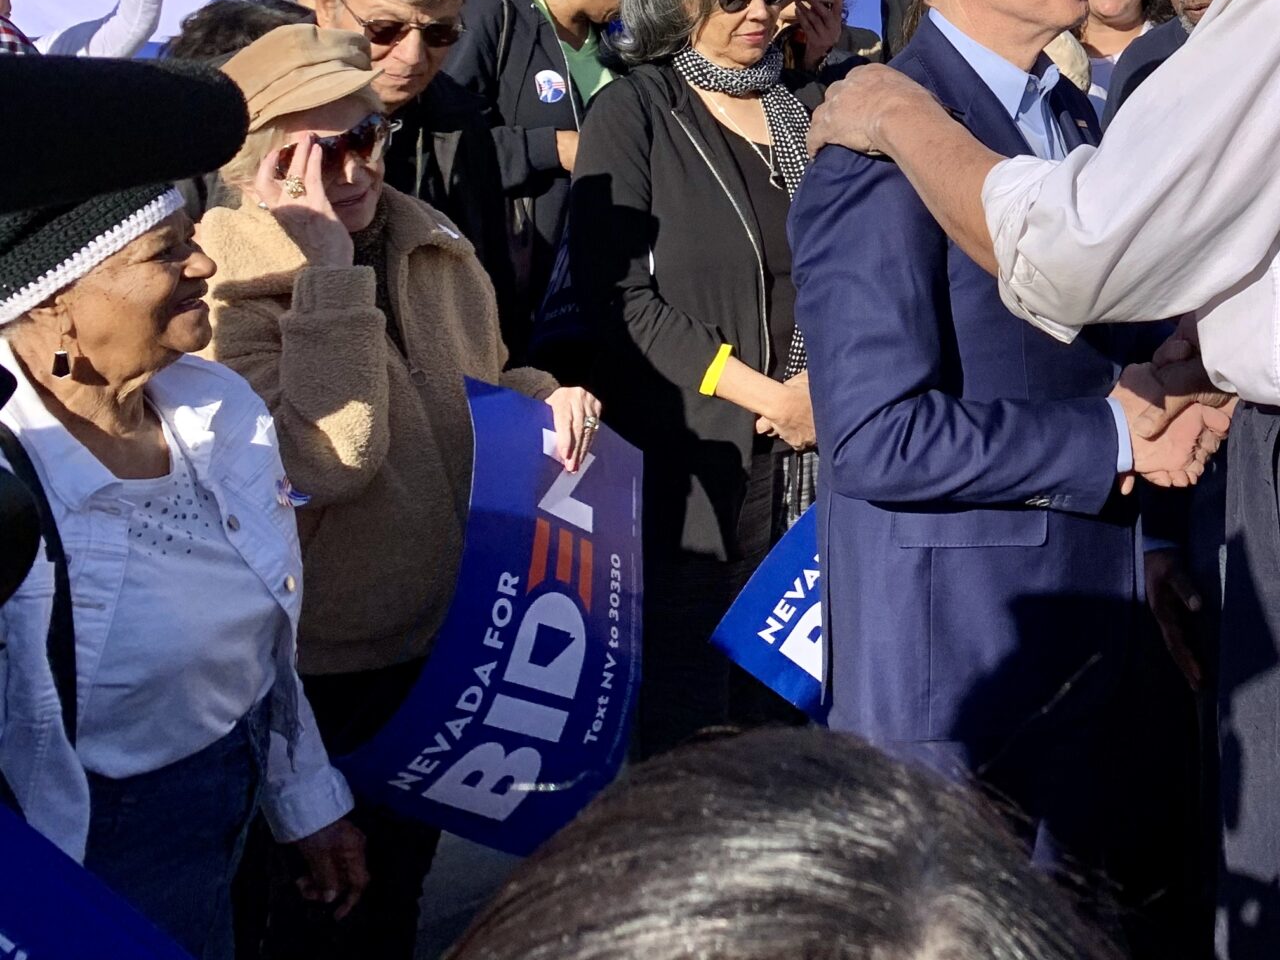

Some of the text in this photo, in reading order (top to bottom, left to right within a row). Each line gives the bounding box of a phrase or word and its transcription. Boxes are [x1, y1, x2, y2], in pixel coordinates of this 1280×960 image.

[387, 571, 520, 791] NEVADA FOR
[421, 427, 596, 821] BIDEN
[583, 553, 621, 744] Text NV to 30330
[757, 554, 821, 644] NEVA
